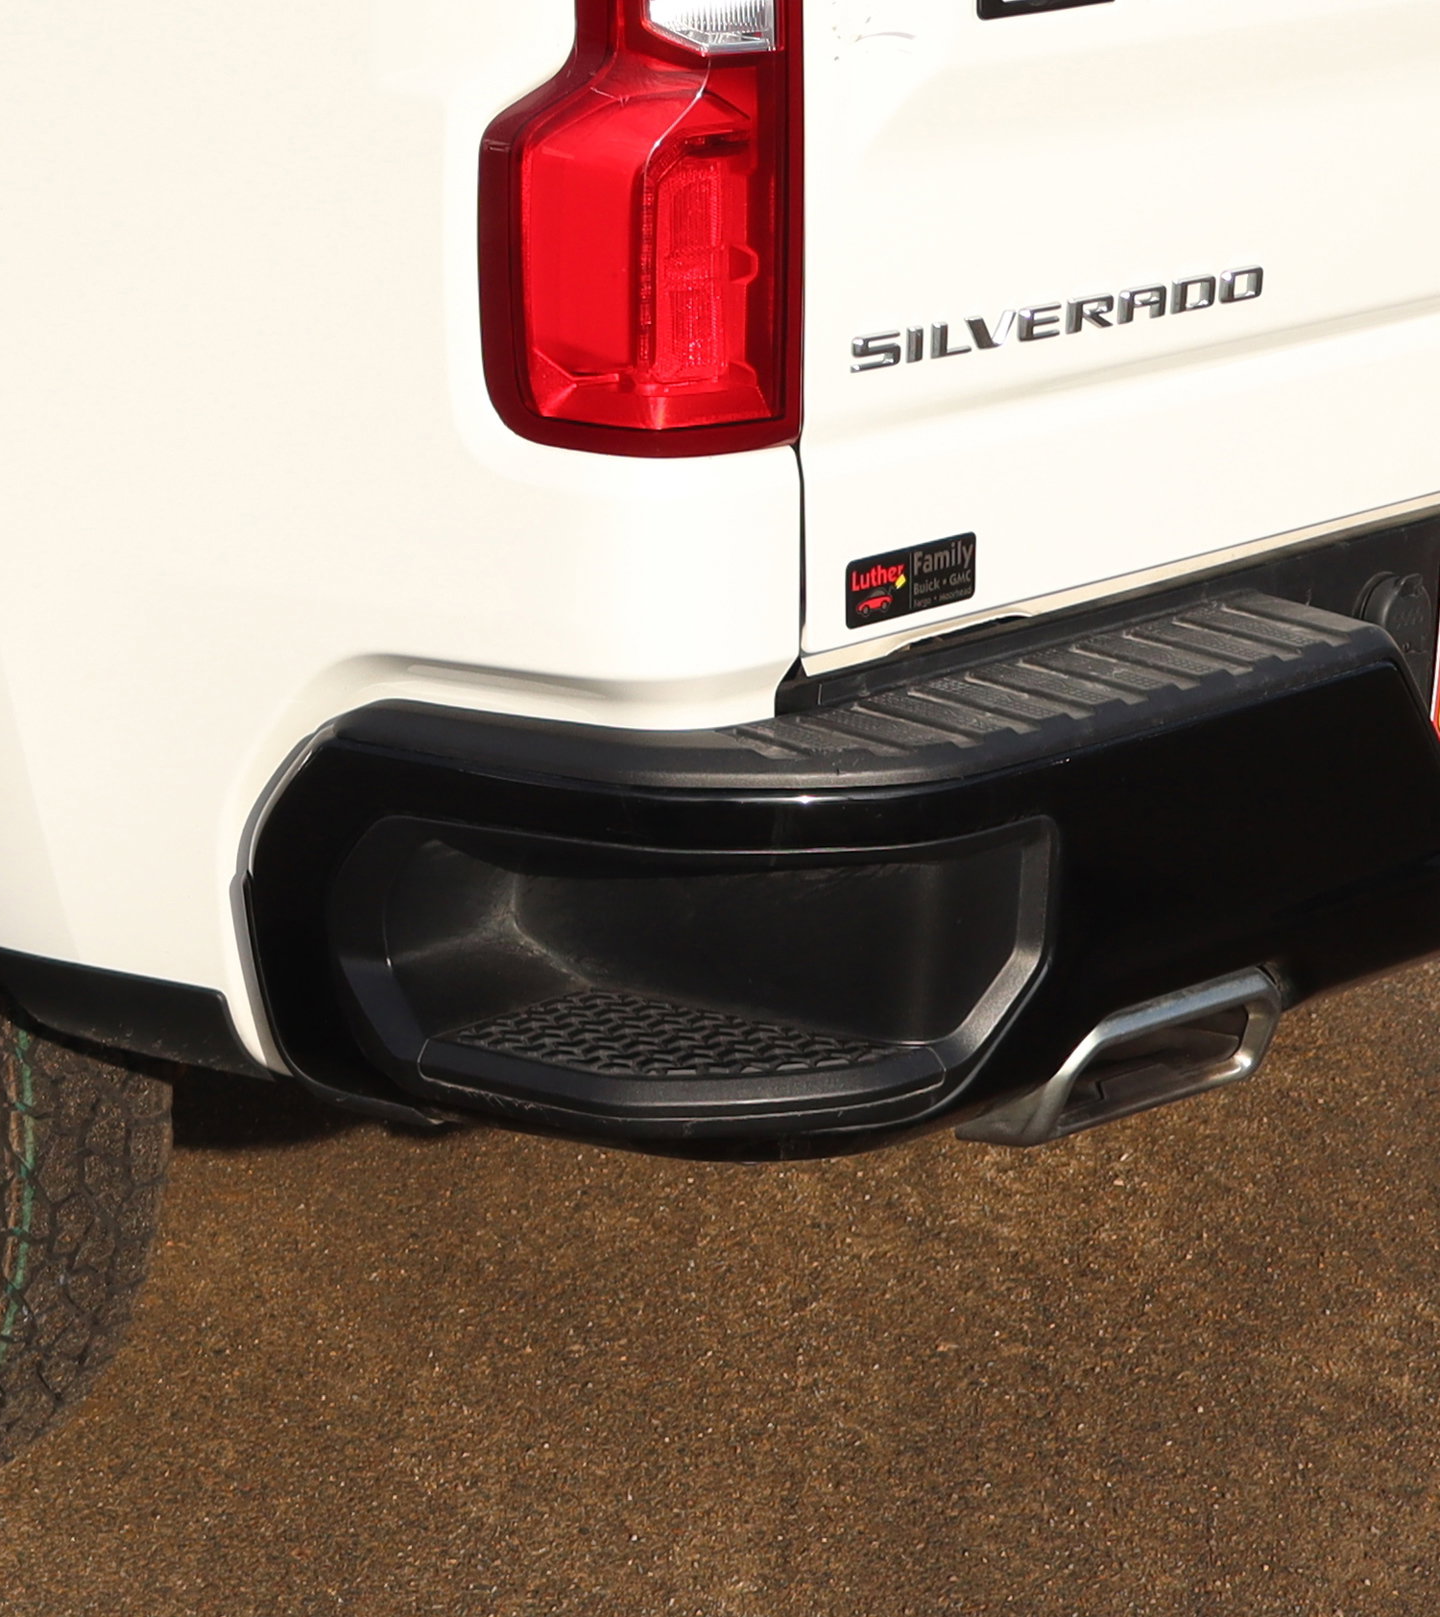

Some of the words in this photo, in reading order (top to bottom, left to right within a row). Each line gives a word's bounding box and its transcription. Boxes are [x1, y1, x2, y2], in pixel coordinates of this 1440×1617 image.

[849, 264, 1265, 374] SILVERADO
[851, 563, 906, 592] Luther
[913, 540, 974, 576] Family
[913, 577, 940, 595] Buick
[949, 569, 972, 586] GMC
